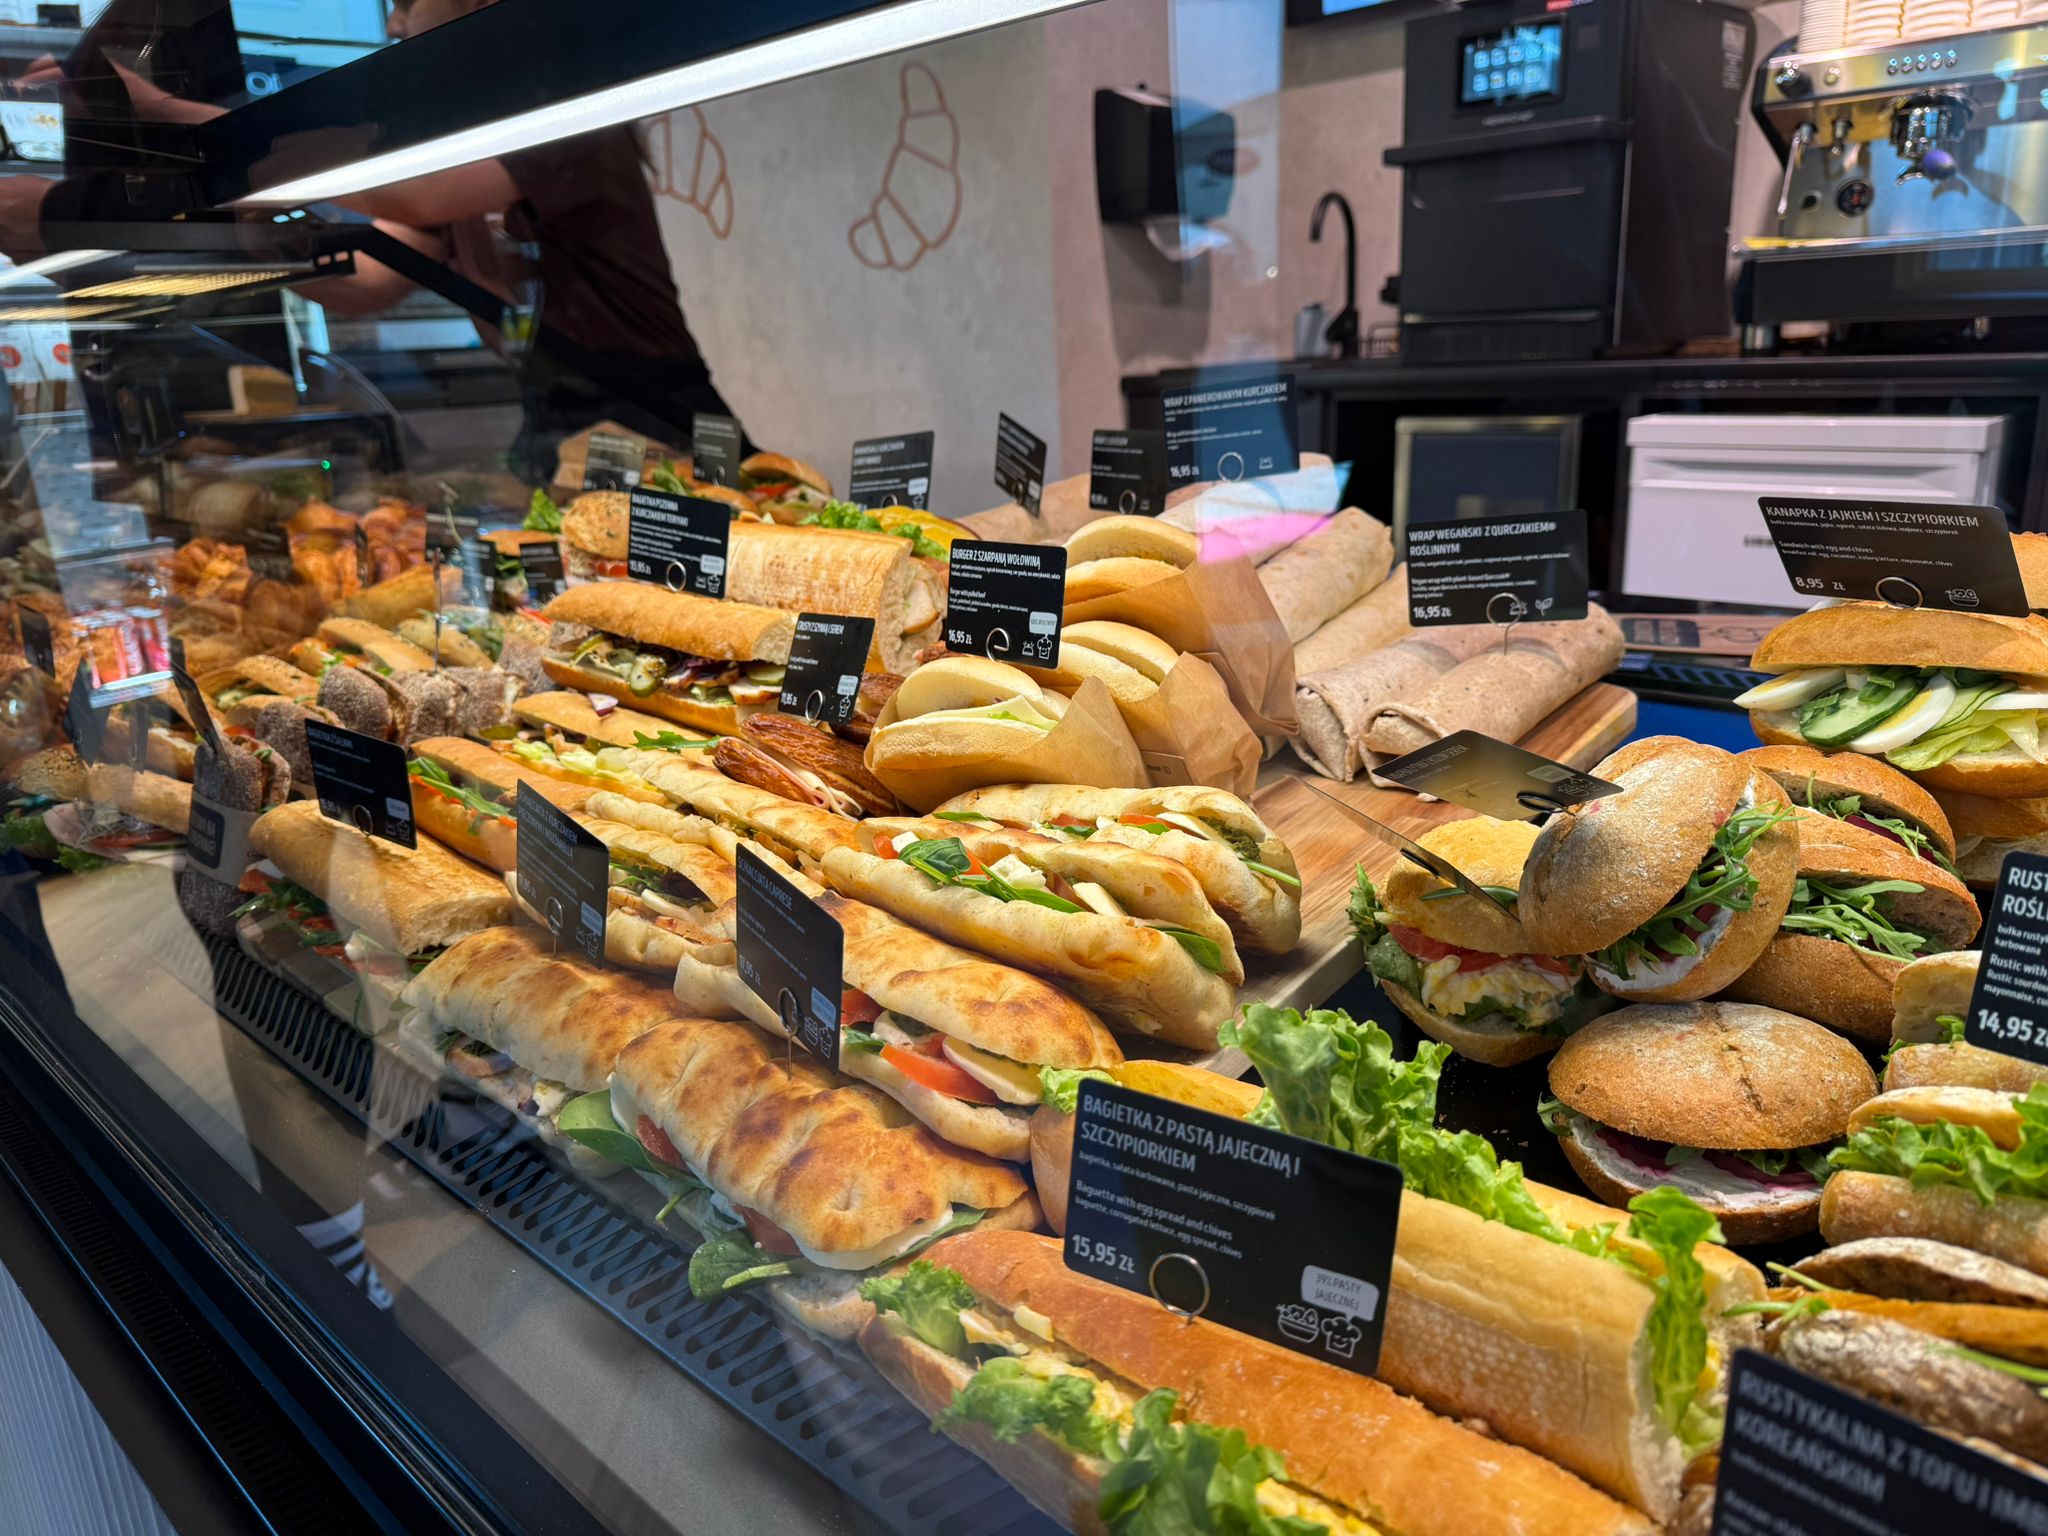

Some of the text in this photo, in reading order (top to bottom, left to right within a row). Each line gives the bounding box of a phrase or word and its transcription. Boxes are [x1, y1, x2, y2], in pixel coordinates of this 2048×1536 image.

[1164, 397, 1183, 408] WRAP
[1244, 383, 1287, 397] KURCZAKIEM
[1766, 506, 1979, 527] KANAPKA Z JAJKIEM I SZCZYPIORKIEM
[1409, 528, 1435, 542] WRAP
[1436, 525, 1482, 540] WEGAŃSKI
[1484, 526, 1490, 536] Z
[952, 548, 1041, 569] BURGER Z SZARPANĄ WOŁOWINĄ
[1410, 543, 1460, 557] ROŚLINNYM
[1795, 576, 1824, 589] 8,95
[1413, 605, 1440, 619] 16,95
[948, 629, 965, 644] 16,95
[2002, 894, 2048, 922] ROŚL
[1997, 923, 2022, 937] bułka
[1995, 936, 2041, 955] karbowana
[1987, 968, 2012, 983] Rustic
[1990, 953, 2047, 978] Rustic with
[1984, 983, 2035, 1004] mayonnaise,
[1978, 1009, 2048, 1048] 14,95 Z
[1081, 1121, 1196, 1173] SZCZYPIORKIEM
[1084, 1094, 1300, 1179] BAGIETKA Z PASTĄ JAJECZNĄ I
[1080, 1150, 1276, 1221] bagietka, sałata karbowana, pasta jajeczna, szczypiorek
[1076, 1179, 1233, 1241] Baguette with egg spread and chives
[1075, 1195, 1243, 1259] baguette, corrugated lettuce, egg spread, chives
[1072, 1234, 1116, 1266] 15,95
[1333, 1278, 1361, 1294] PASTY
[1738, 1369, 1886, 1462] RUSTYKALNA
[1886, 1435, 1907, 1473] Z
[1907, 1445, 1977, 1504] TOFU
[1733, 1406, 1886, 1504] KOREAŃSKIM
